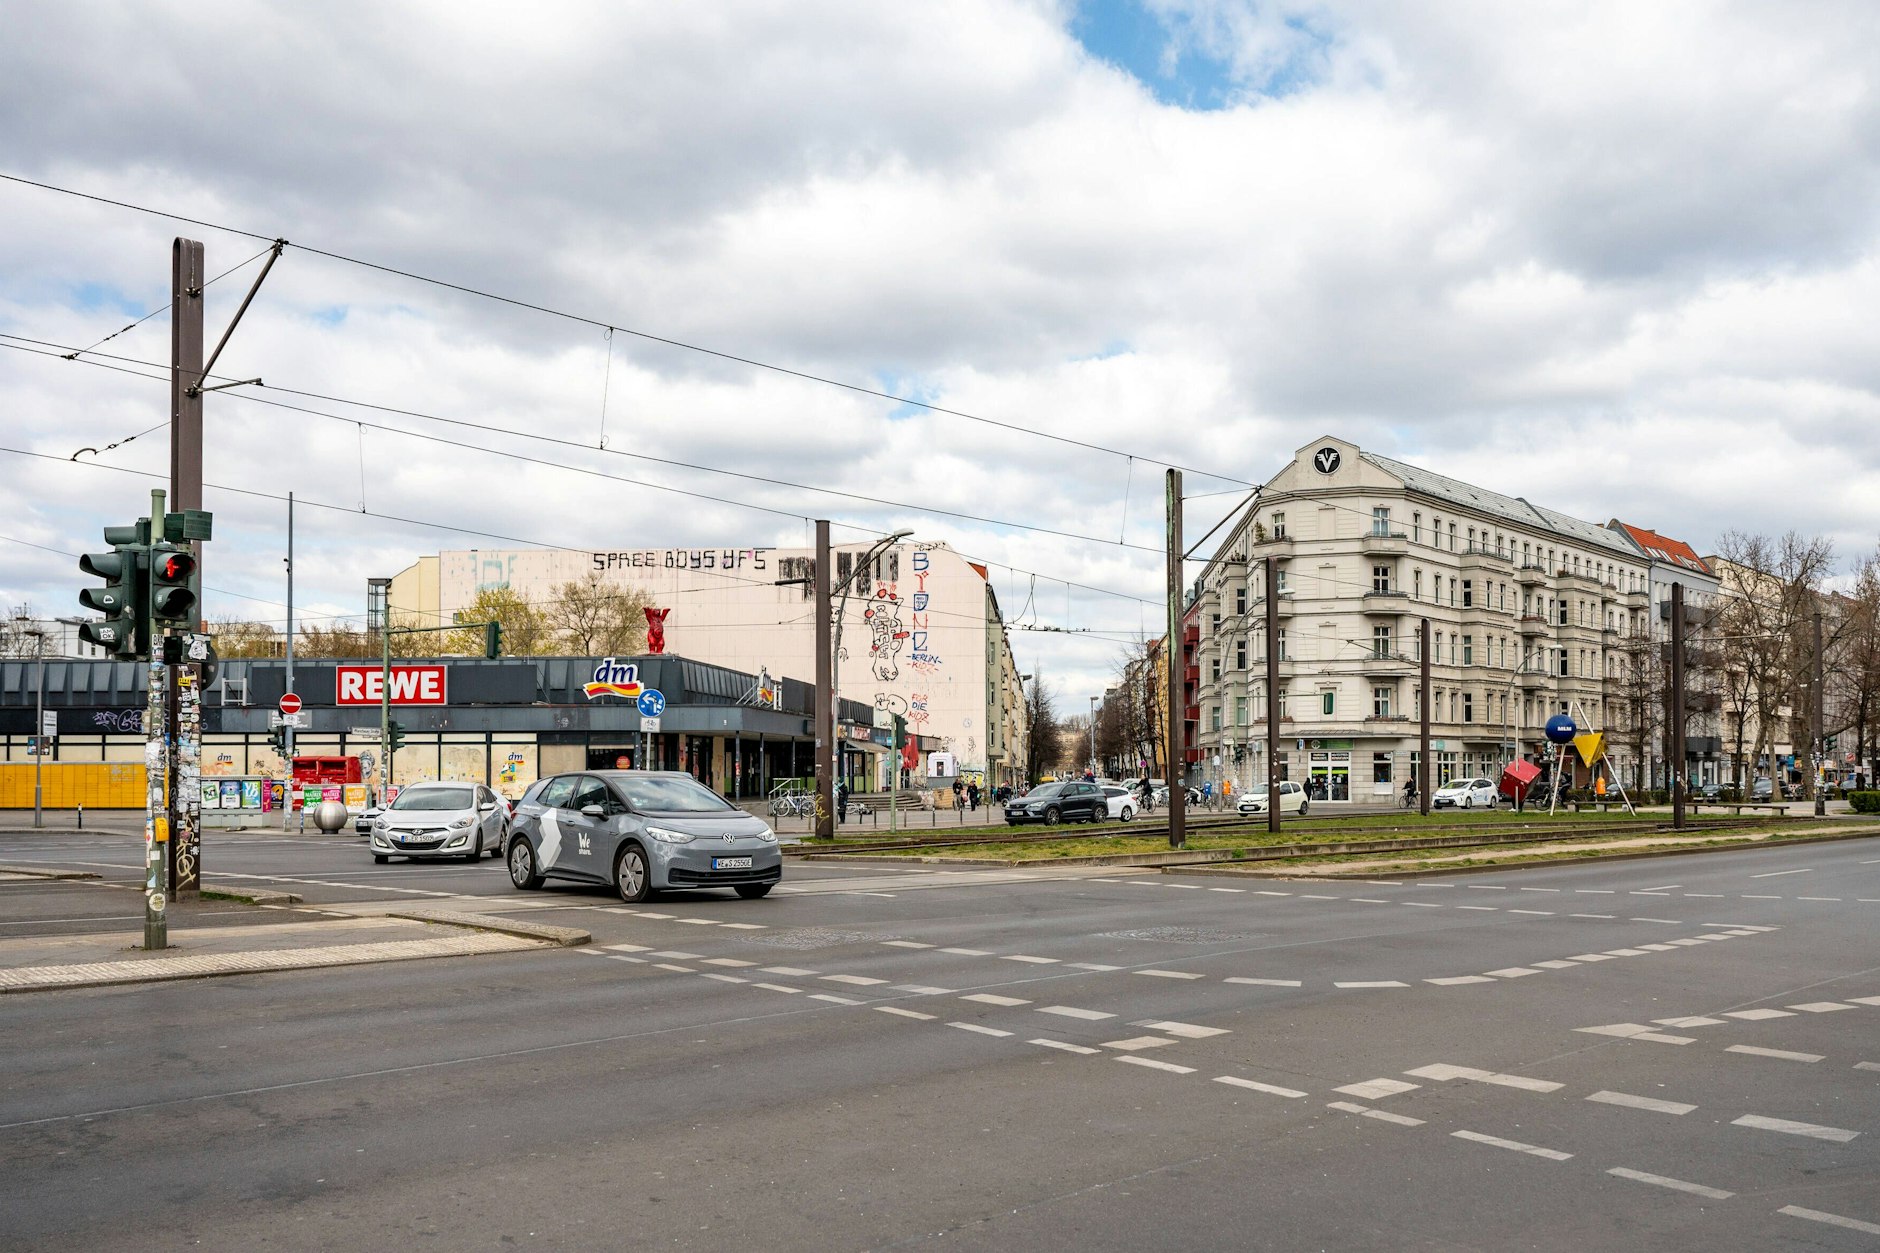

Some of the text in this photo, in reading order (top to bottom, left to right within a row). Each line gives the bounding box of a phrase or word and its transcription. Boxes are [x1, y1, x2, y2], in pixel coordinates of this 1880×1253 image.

[593, 551, 655, 570] SPREE
[596, 660, 634, 682] dm
[341, 671, 440, 700] REWE
[217, 752, 232, 761] dm
[508, 752, 523, 761] dm
[578, 832, 591, 849] We
